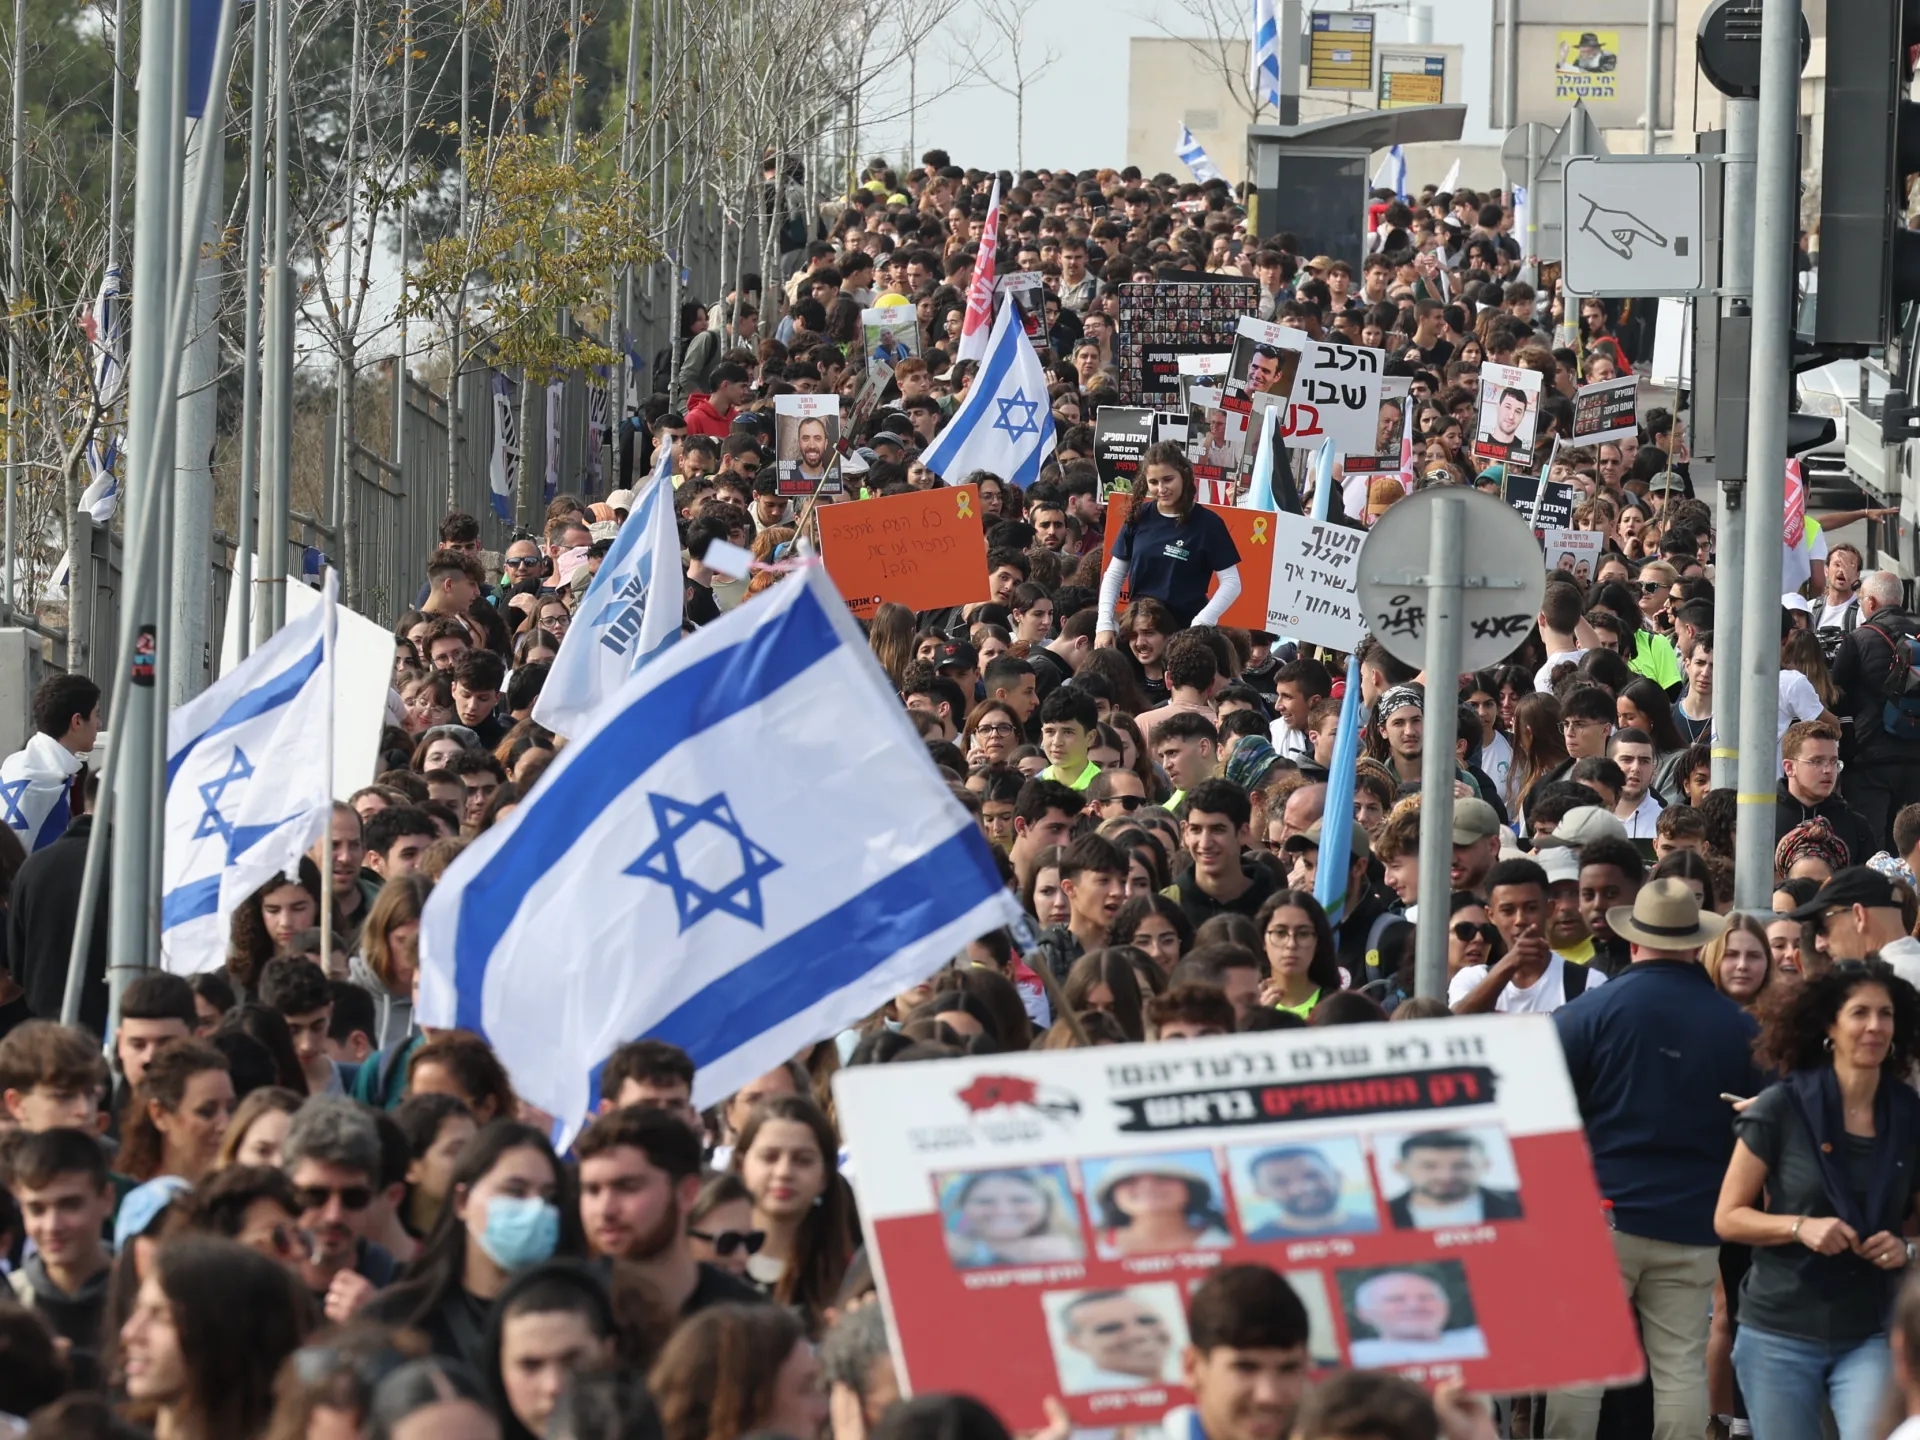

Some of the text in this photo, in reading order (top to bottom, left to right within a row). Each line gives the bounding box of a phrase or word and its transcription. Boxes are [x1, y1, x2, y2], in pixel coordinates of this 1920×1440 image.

[1557, 75, 1615, 85] יחי המלך
[1556, 86, 1614, 97] המשיח
[1314, 345, 1377, 373] הלב
[1228, 377, 1247, 389] BRING
[1225, 386, 1238, 397] HIM
[1302, 379, 1367, 410] שבוי
[1188, 445, 1206, 456] BRING
[778, 460, 797, 470] BRING
[779, 470, 791, 480] HIM
[1512, 500, 1568, 515] איבדנו ספיק.
[922, 506, 942, 528] כל
[1540, 515, 1558, 523] חייבים
[882, 516, 911, 535] העם
[1536, 522, 1555, 530] החטופי
[1311, 525, 1361, 554] חטוף
[867, 543, 886, 560] את
[1284, 562, 1305, 581] אף
[617, 575, 643, 600] עד
[1105, 1036, 1486, 1089] זה לא שלם בלעדיהם!
[1143, 1072, 1481, 1128] רק החטופים בראש
